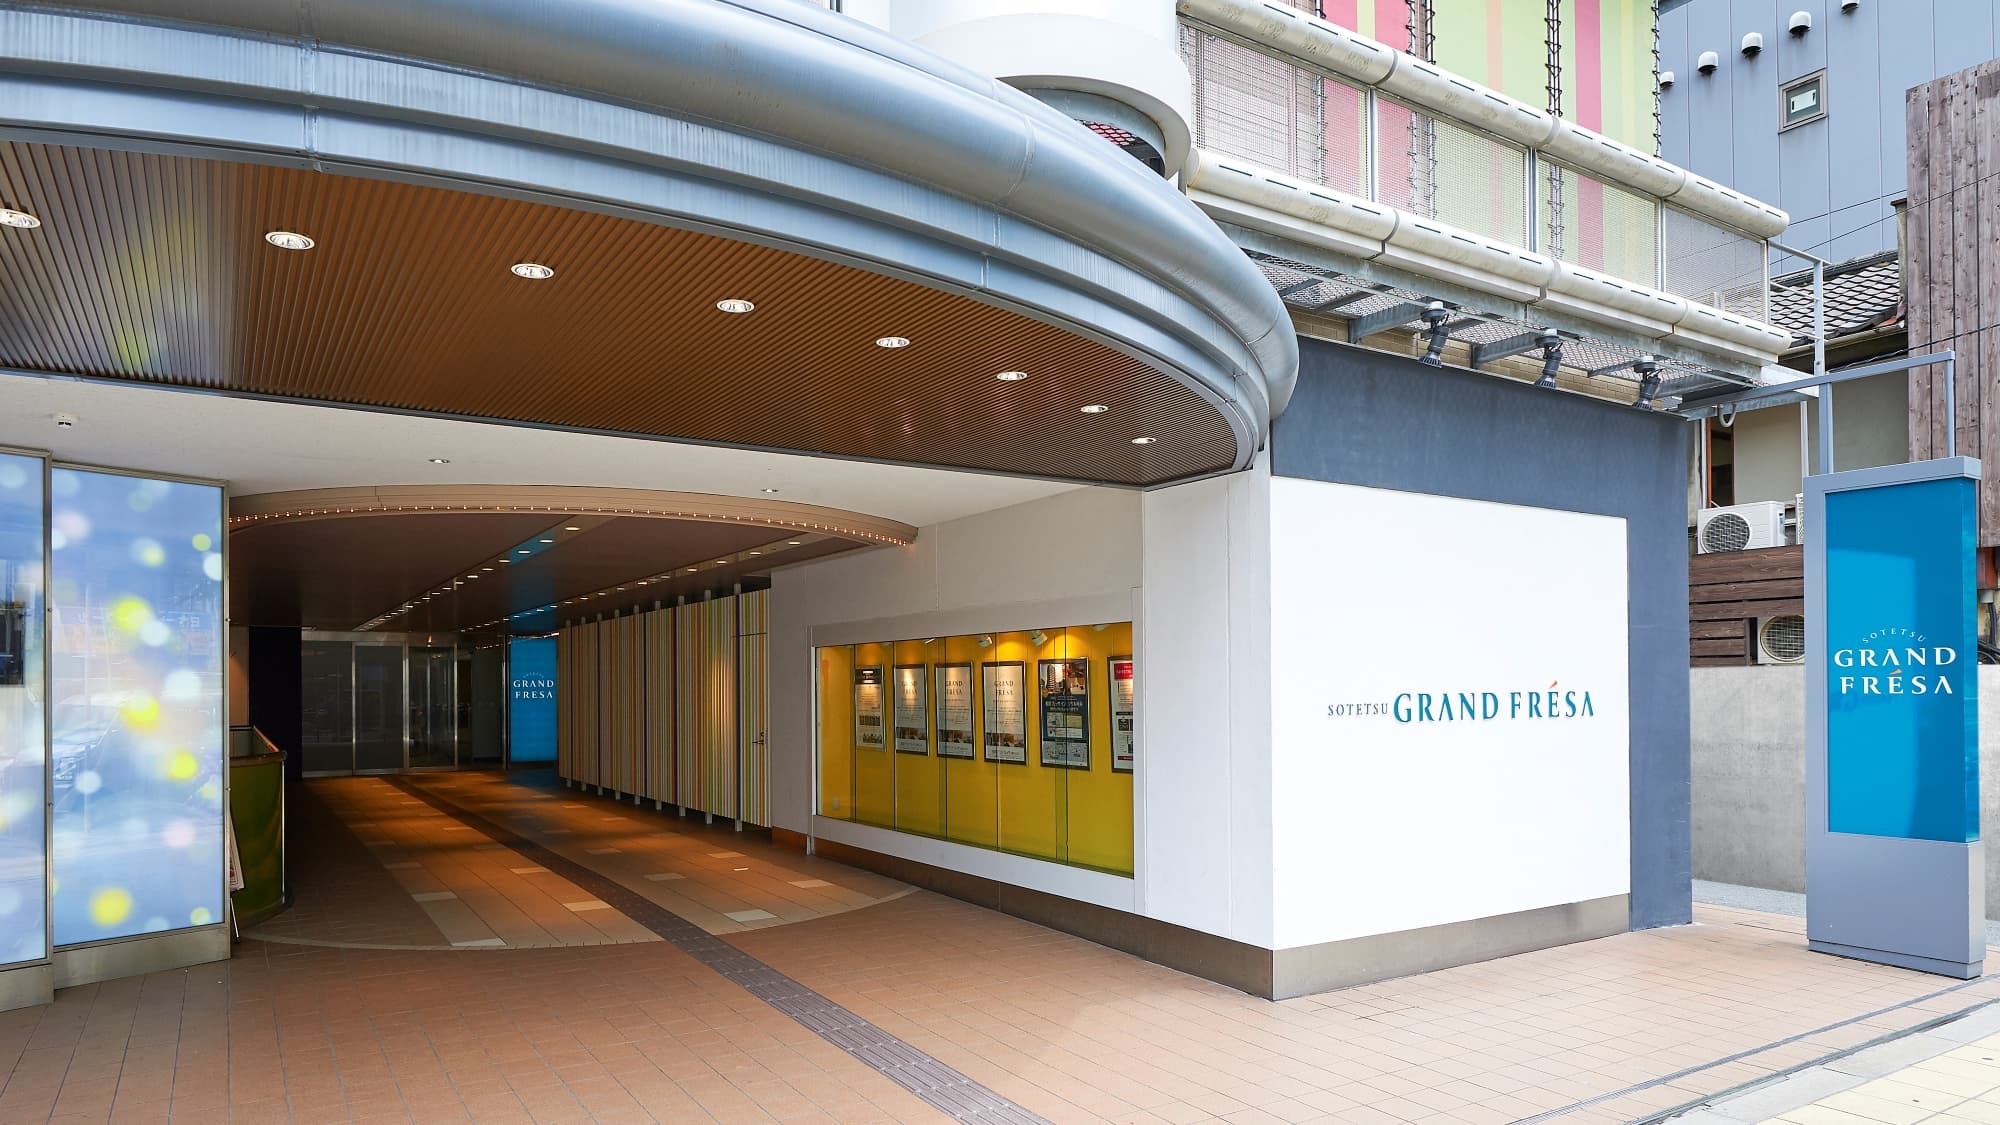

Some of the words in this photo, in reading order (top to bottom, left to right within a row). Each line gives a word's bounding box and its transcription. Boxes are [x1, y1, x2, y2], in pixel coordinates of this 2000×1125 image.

[1862, 627, 1926, 643] SOTETSU
[1834, 647, 1957, 667] GRAND
[513, 679, 554, 688] GRAND
[1327, 703, 1389, 716] SOTETSU
[1393, 692, 1499, 723] GRAND
[1510, 680, 1594, 719] FRÉSA
